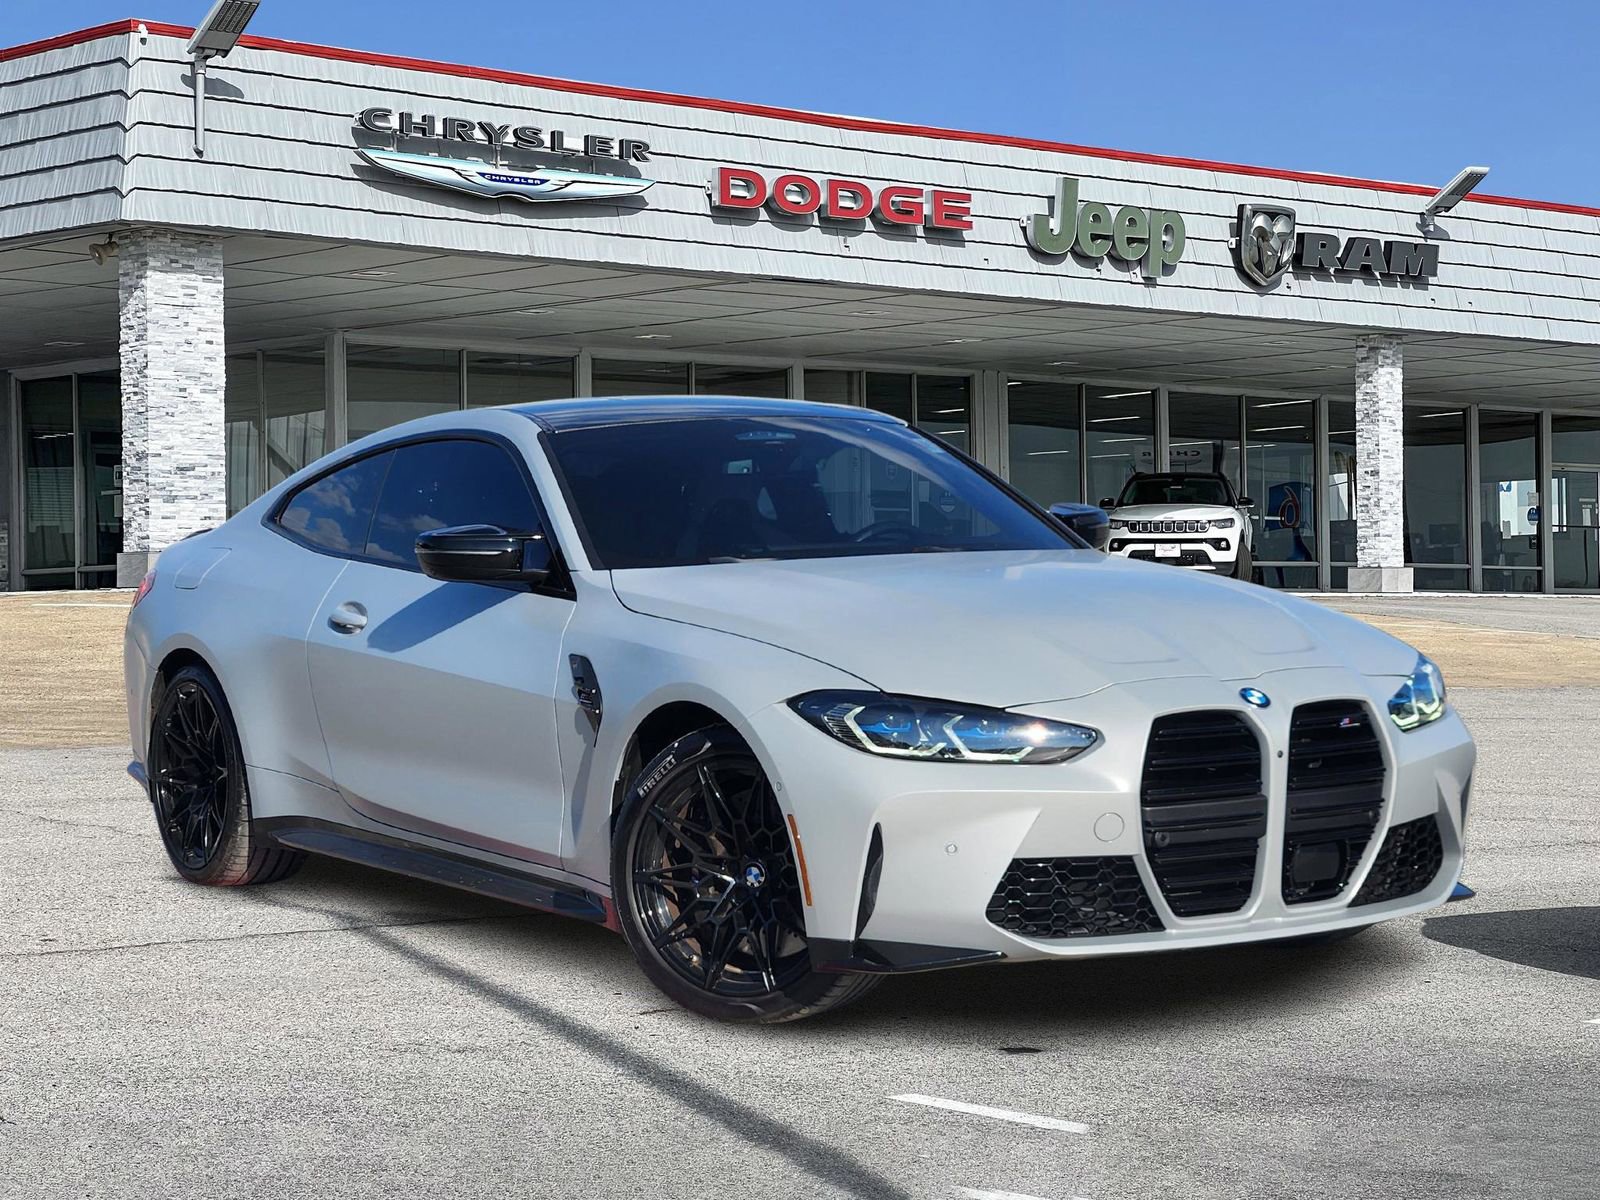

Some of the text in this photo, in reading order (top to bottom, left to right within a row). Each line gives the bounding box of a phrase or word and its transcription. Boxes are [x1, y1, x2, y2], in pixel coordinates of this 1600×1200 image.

[358, 107, 650, 163] CHRYSLER
[484, 174, 541, 185] CHRYSLER
[714, 167, 973, 231] DODGE
[1031, 177, 1187, 278] Jeep
[1298, 232, 1440, 277] RAM
[637, 756, 677, 798] PIRELLI
